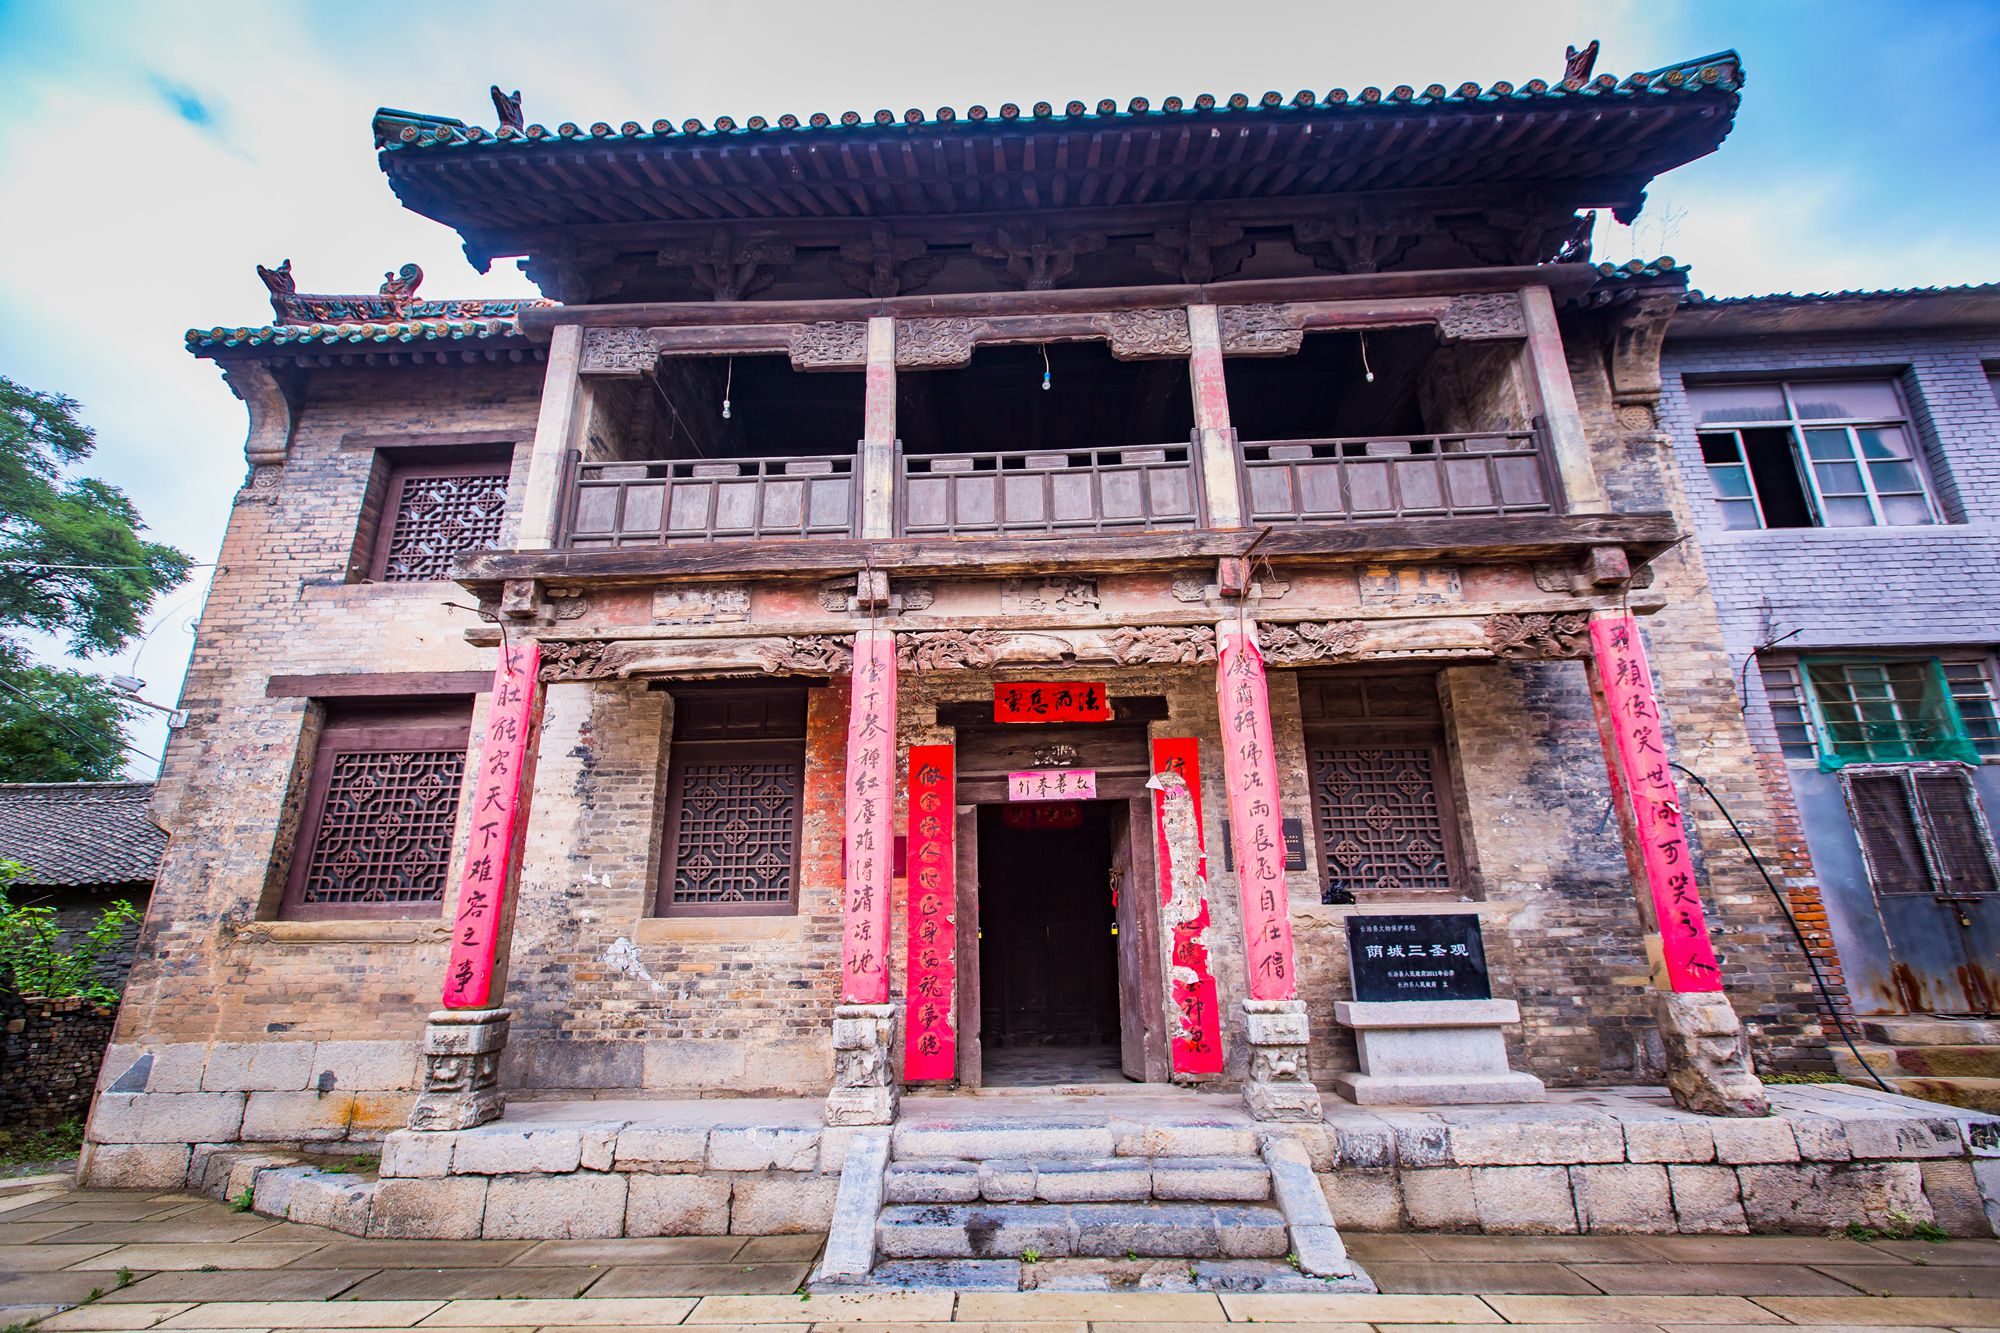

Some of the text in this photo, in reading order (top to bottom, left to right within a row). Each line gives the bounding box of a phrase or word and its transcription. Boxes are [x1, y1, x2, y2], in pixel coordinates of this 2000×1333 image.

[1365, 943, 1470, 959] 荫城三圣观
